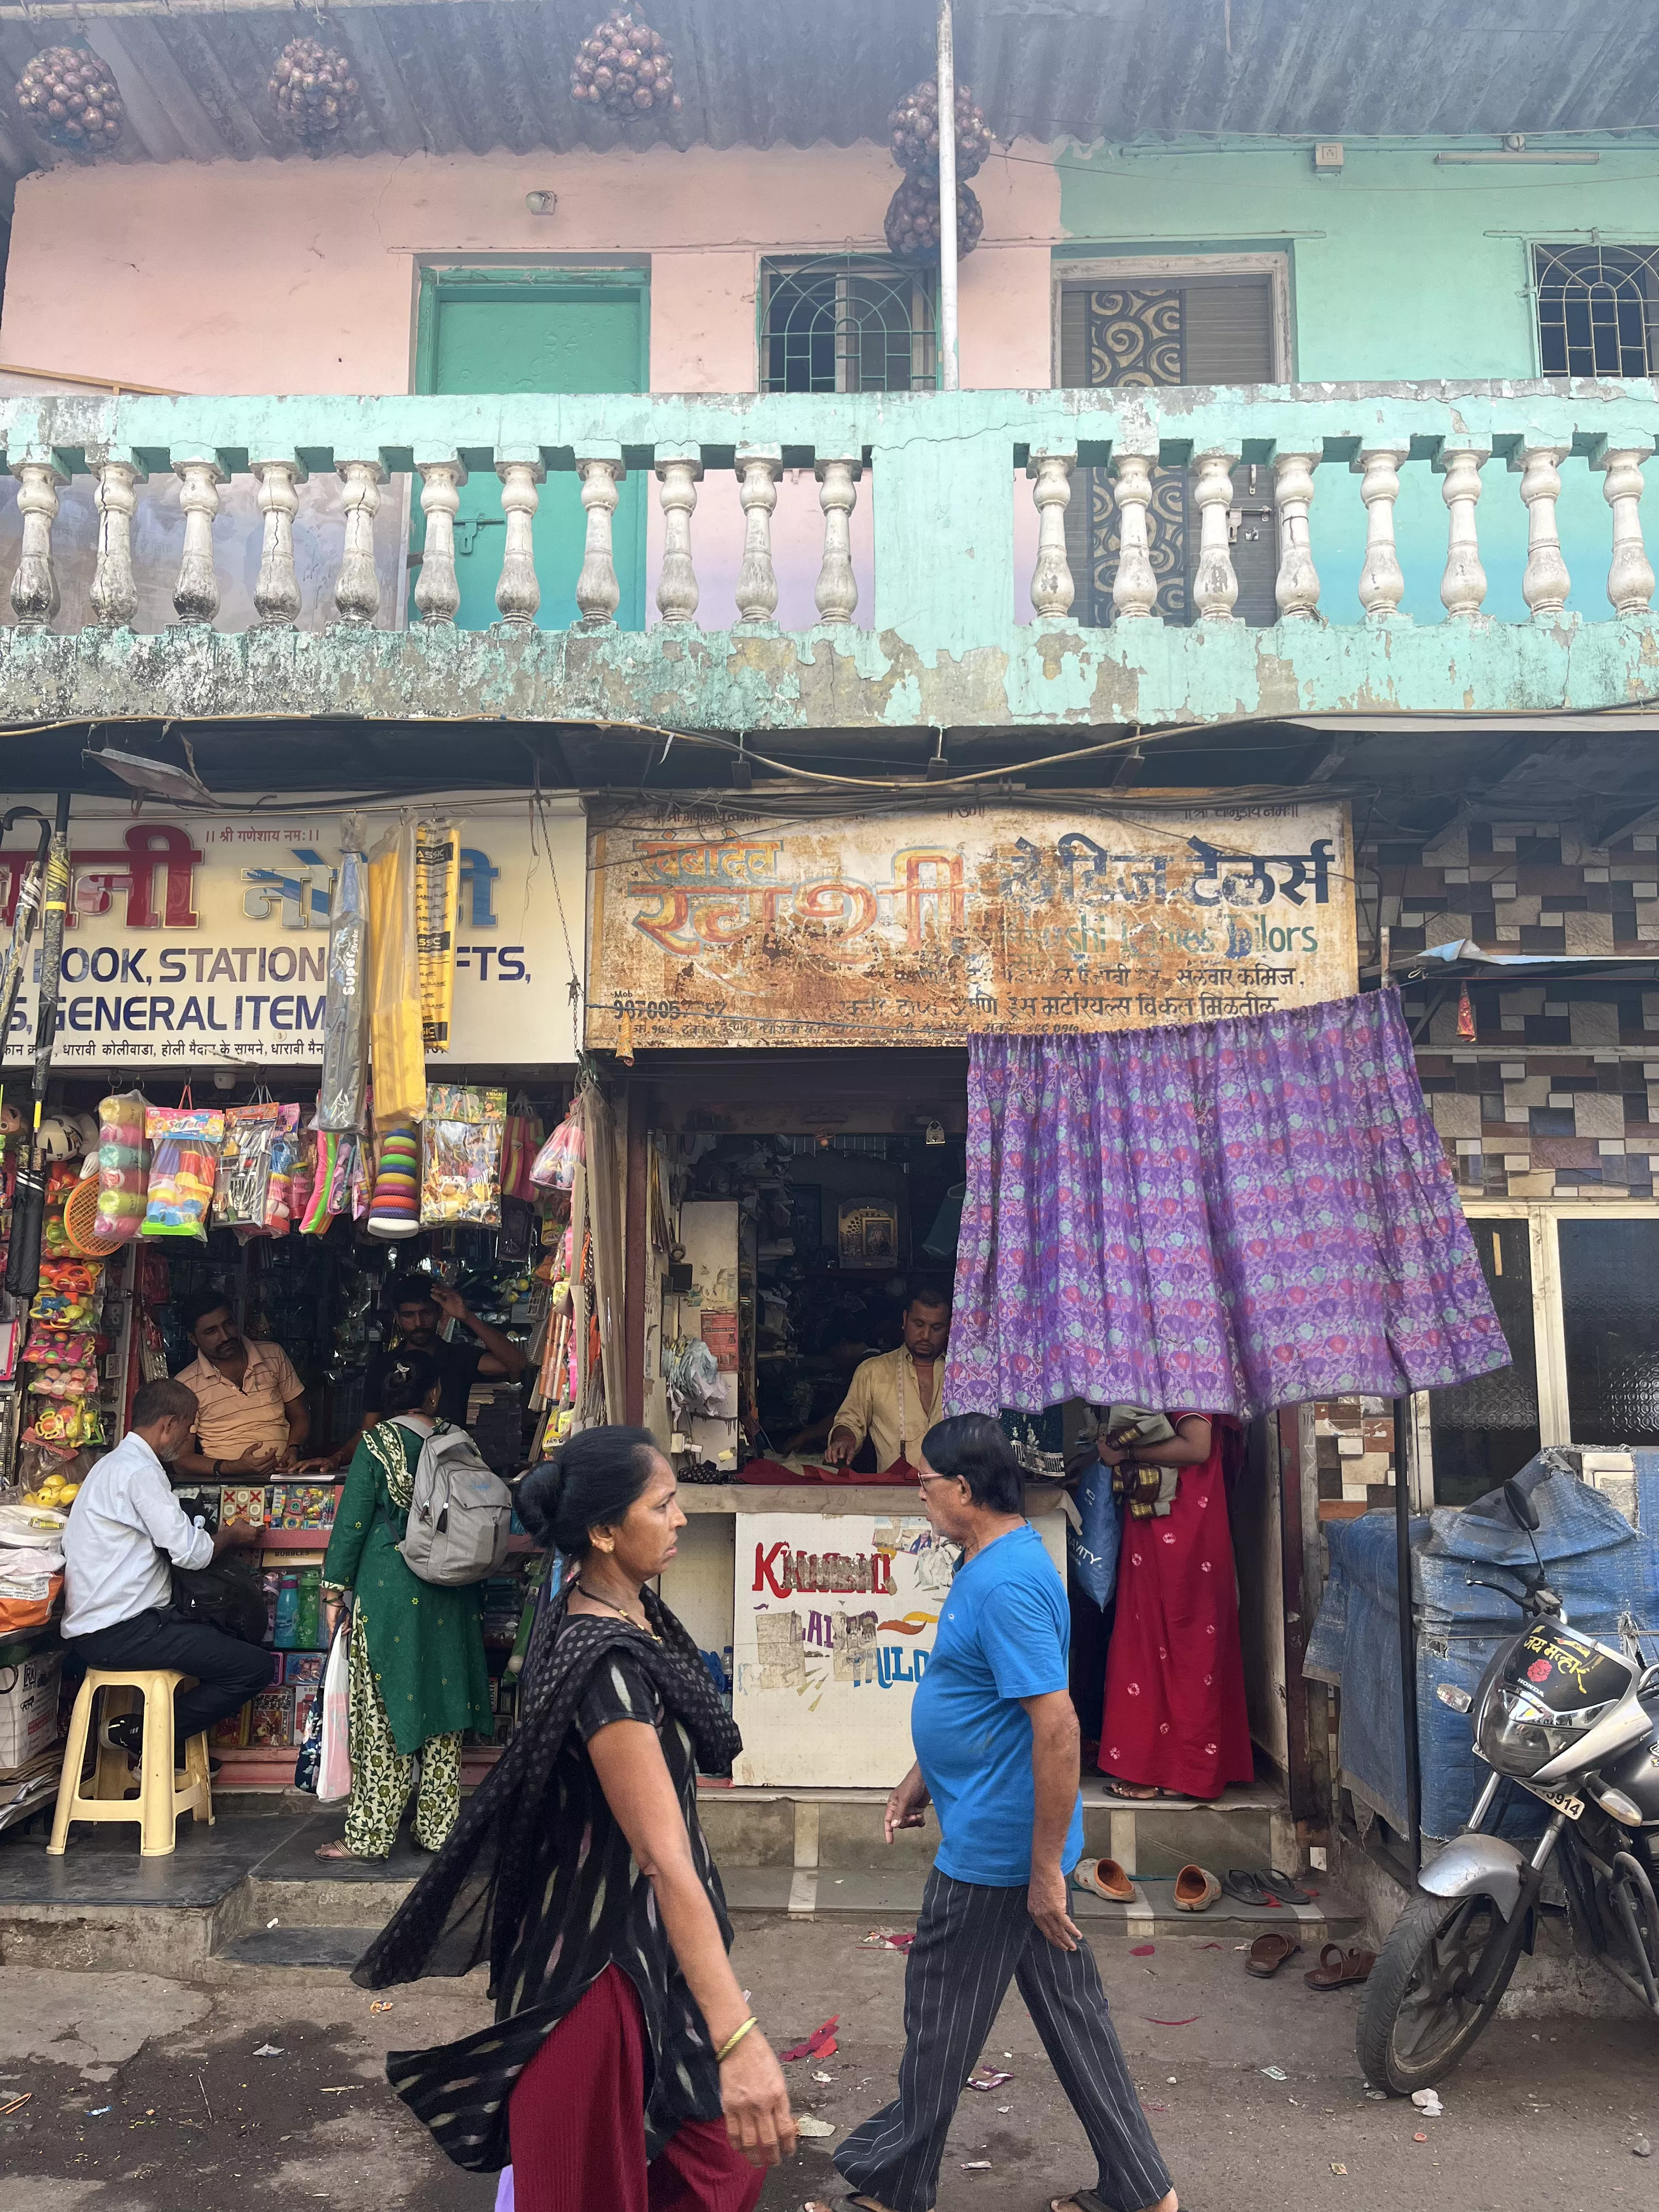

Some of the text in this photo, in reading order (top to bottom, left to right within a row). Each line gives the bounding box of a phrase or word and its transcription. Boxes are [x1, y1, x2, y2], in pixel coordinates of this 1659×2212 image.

[219, 826, 234, 843] श्री
[238, 826, 281, 843] गणेशाय
[416, 849, 444, 859] ASSIC
[1181, 835, 1336, 907] टेलर्स
[160, 946, 330, 982] STATION
[456, 946, 531, 984] FTS,
[342, 951, 356, 996] Super
[235, 995, 326, 1030] ITEM
[1136, 992, 1194, 1017] विकत
[63, 1040, 95, 1056] धारावी
[102, 1040, 156, 1057] कोलीवाडा,
[161, 1040, 185, 1056] होली
[220, 1040, 230, 1055] के
[234, 1040, 268, 1056] सामने,
[271, 1040, 303, 1056] धारावी
[1517, 1677, 1544, 1698] HONDA
